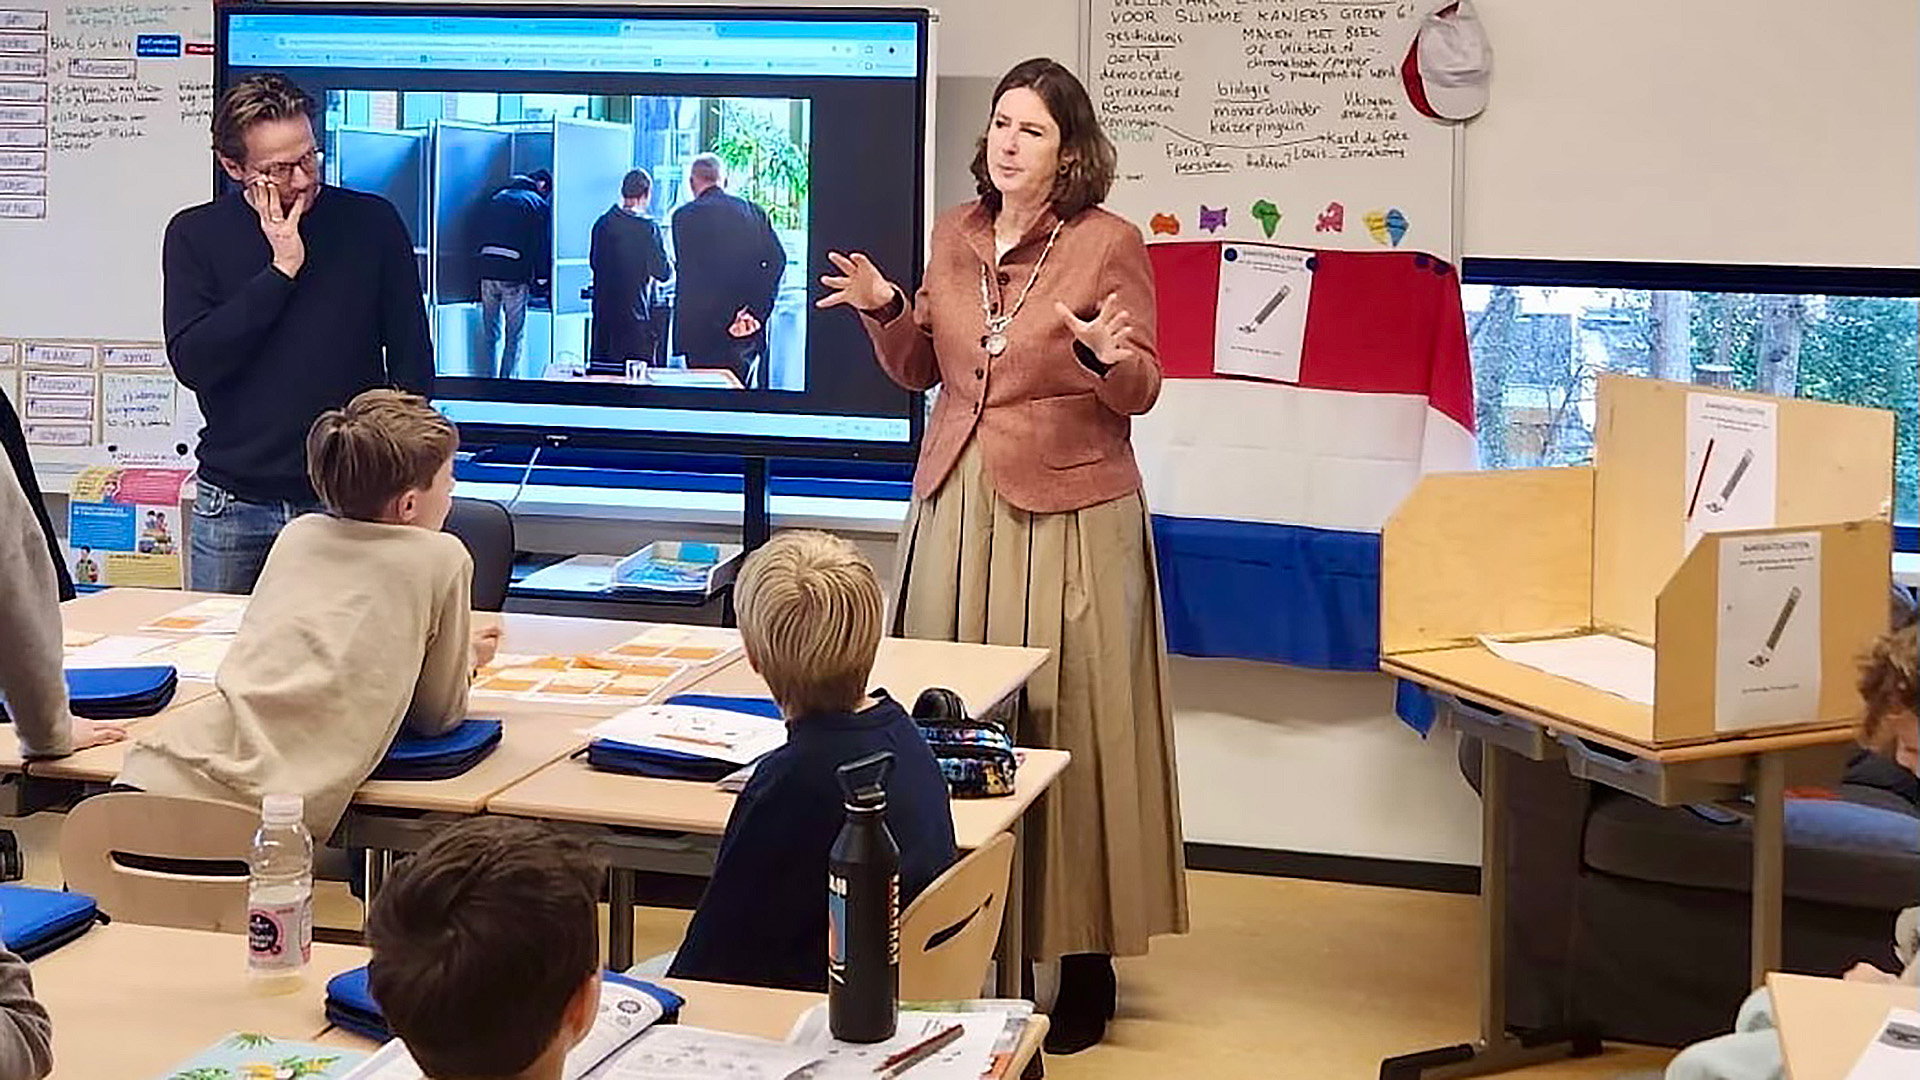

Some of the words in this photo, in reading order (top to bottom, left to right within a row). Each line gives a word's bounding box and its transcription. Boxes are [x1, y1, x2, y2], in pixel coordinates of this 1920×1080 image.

[1111, 11, 1158, 24] VOOR
[1175, 8, 1242, 23] SLIMME
[1257, 8, 1329, 22] KANJERS
[1340, 8, 1386, 20] GROEP
[1105, 29, 1183, 48] geschiedenis
[1242, 28, 1292, 41] MAKEN
[1307, 28, 1336, 39] MET
[1346, 26, 1381, 39] BOEK
[1100, 65, 1183, 81] democratie
[1103, 84, 1180, 102] Griekenland
[1341, 108, 1398, 121] anarchie
[1166, 142, 1200, 158] Floris
